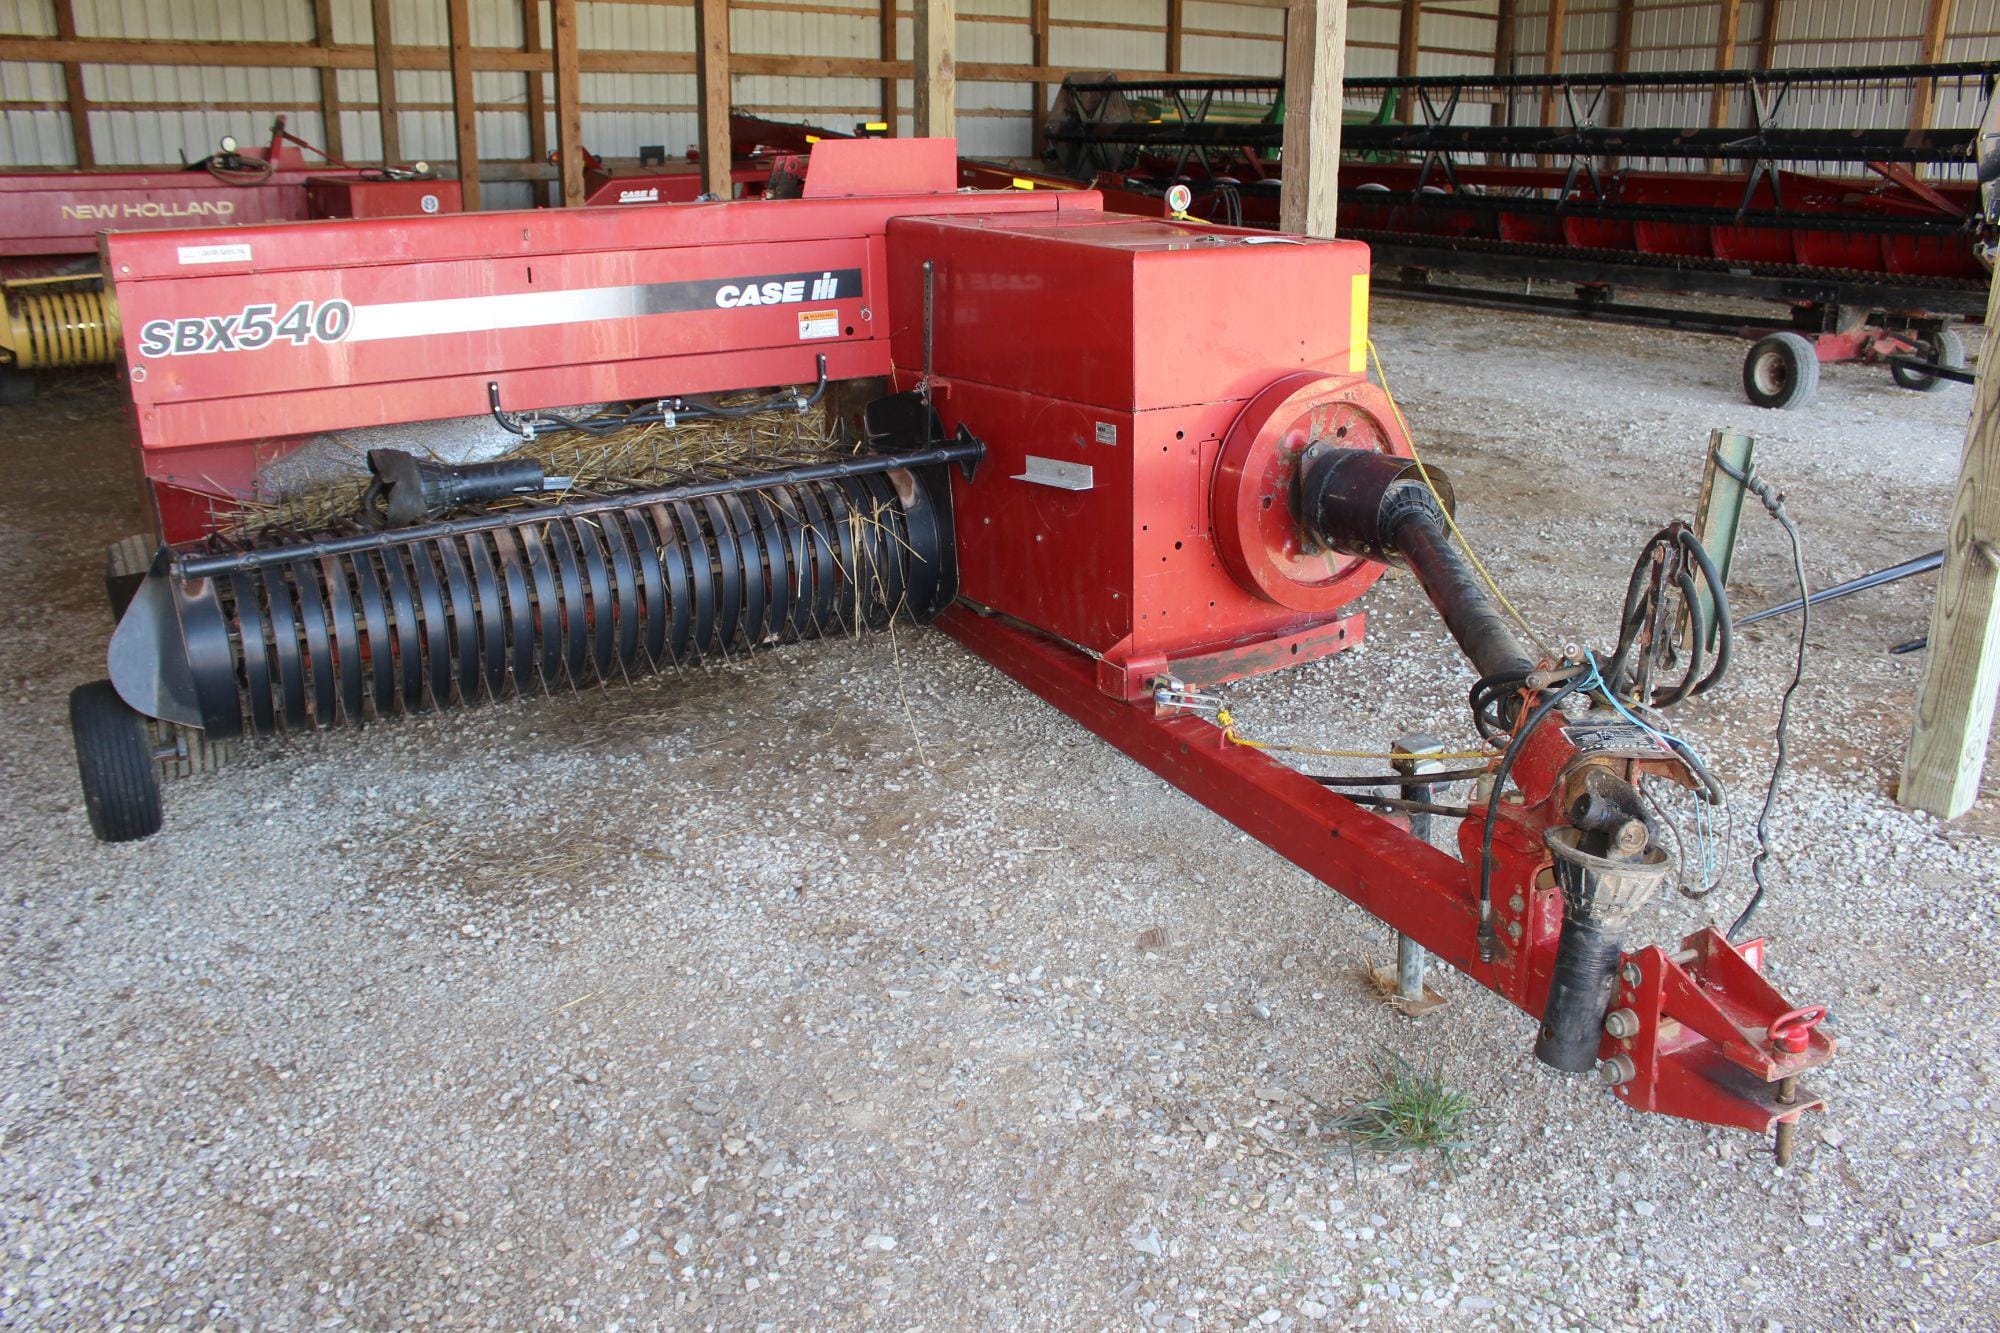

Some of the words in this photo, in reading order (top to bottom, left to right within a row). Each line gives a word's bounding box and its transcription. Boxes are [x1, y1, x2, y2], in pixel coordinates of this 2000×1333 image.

[620, 190, 648, 198] CASE
[62, 204, 117, 219] NEW
[123, 201, 235, 217] HOLLAND
[715, 281, 805, 308] CASE
[140, 299, 352, 358] SBX540
